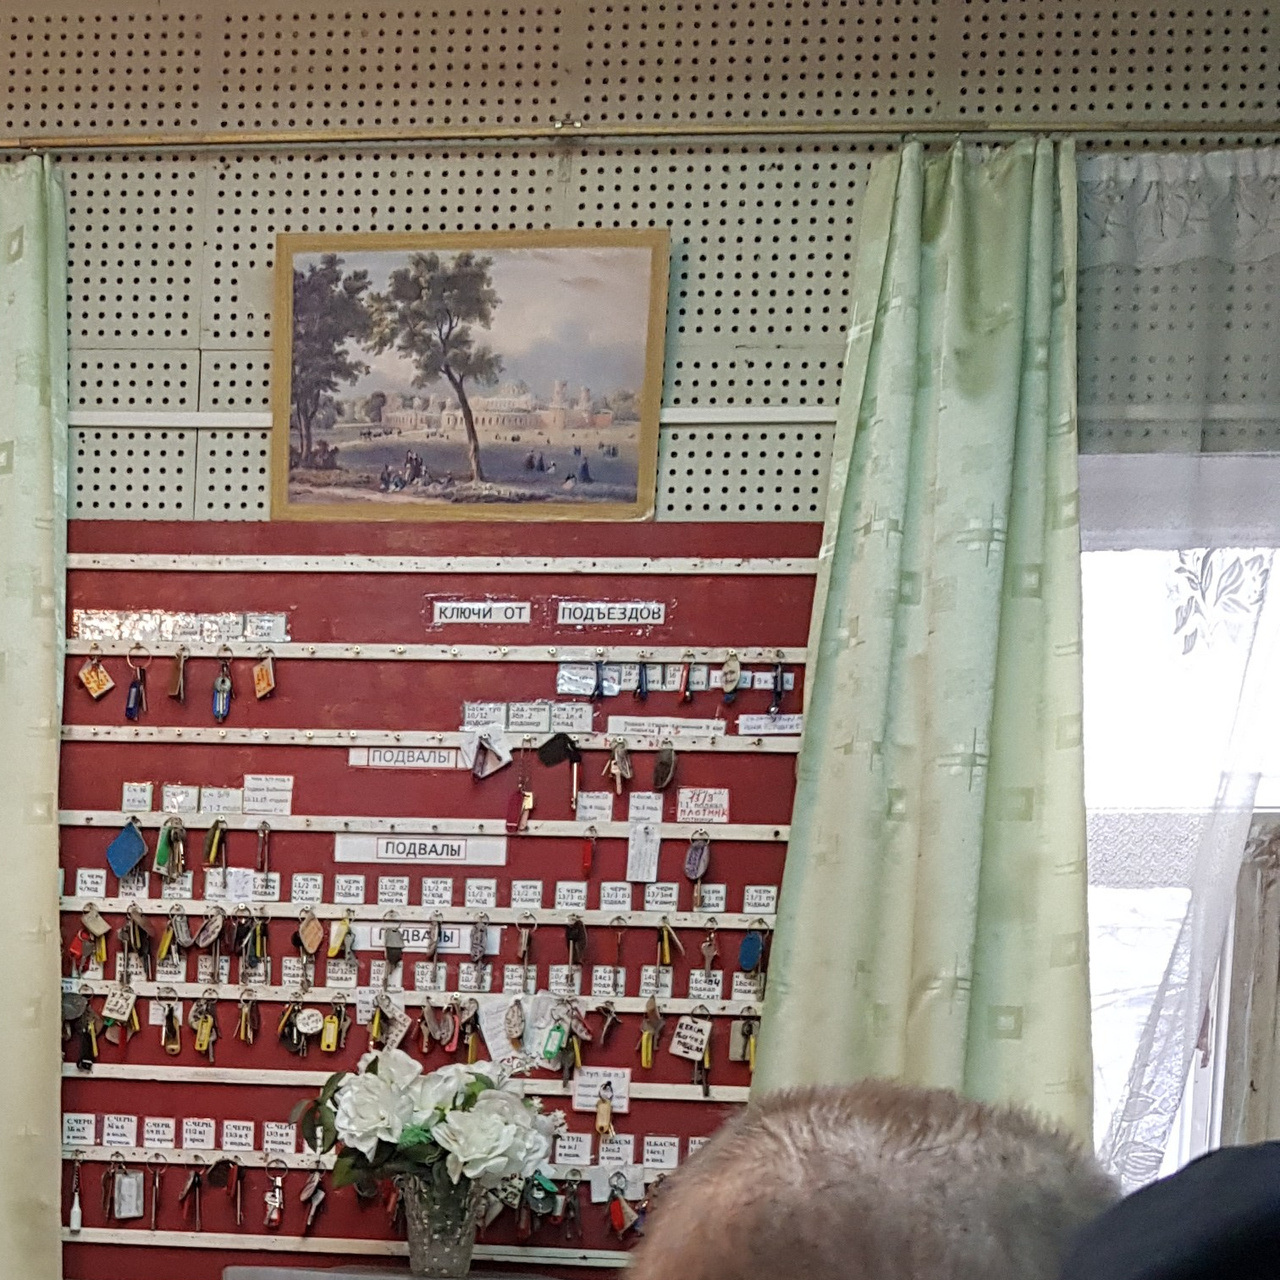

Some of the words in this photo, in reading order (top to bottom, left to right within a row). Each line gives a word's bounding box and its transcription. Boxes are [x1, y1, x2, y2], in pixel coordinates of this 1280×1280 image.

[439, 606, 493, 620] КЛЮЧИ
[505, 606, 526, 620] ОТ
[562, 606, 662, 622] ПОДЪЕЗДОВ
[372, 750, 450, 764] ПОДВАЛЫ
[385, 841, 461, 858] ПОДВАЛЫ
[379, 929, 454, 944] ПДВАЫ
